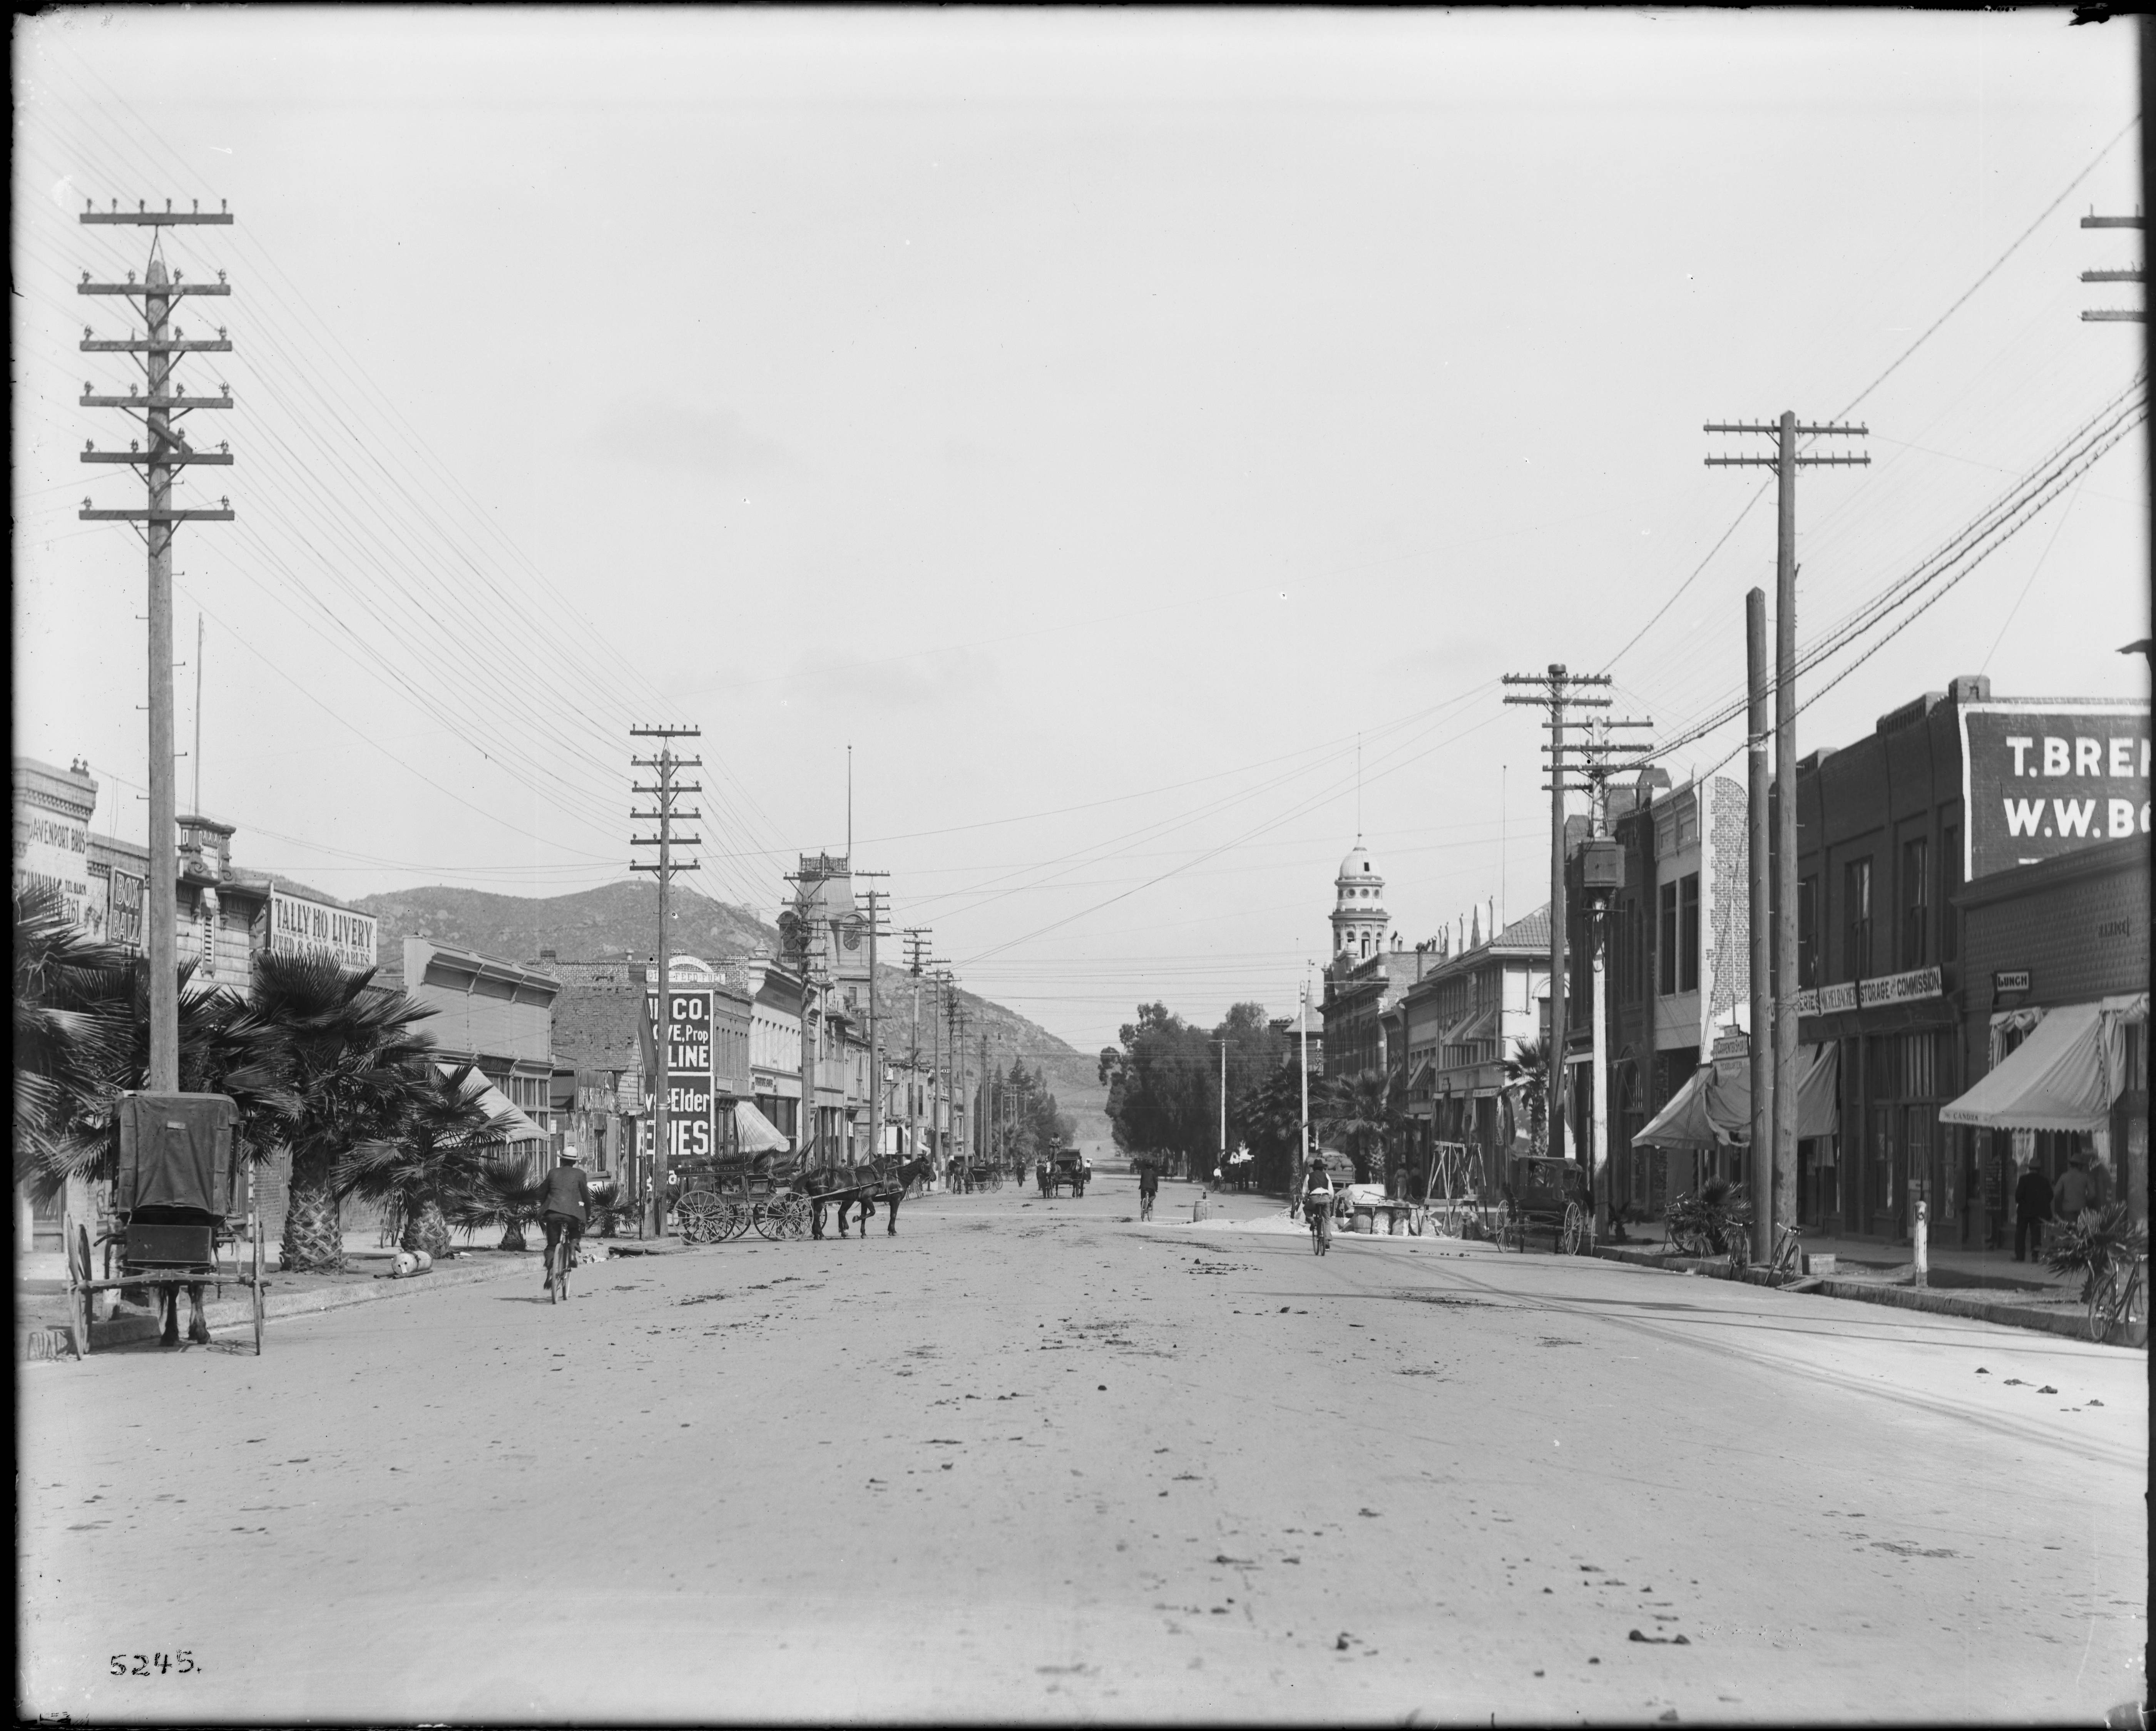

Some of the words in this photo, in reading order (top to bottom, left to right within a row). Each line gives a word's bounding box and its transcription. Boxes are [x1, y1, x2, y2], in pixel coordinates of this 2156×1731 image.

[116, 873, 140, 909] BOX
[111, 909, 141, 945] BALL
[275, 898, 311, 935] TALLY
[313, 908, 328, 938] HO
[332, 913, 373, 949] LIVERY
[273, 934, 295, 953] FEED
[298, 940, 303, 954] &
[336, 948, 370, 967] STABLES
[675, 973, 698, 981] FEED
[702, 974, 724, 983] FUEL
[1997, 976, 2027, 987] LUNCH
[1860, 980, 1890, 1003] STORAGE
[673, 998, 709, 1020] CO.
[686, 1024, 709, 1044] Prop
[668, 1045, 709, 1067] LINE
[1717, 1041, 1735, 1054] CARPENTER
[1735, 1039, 1744, 1053] SHOP
[671, 1088, 710, 1112] Elder
[646, 1120, 709, 1155] EIES
